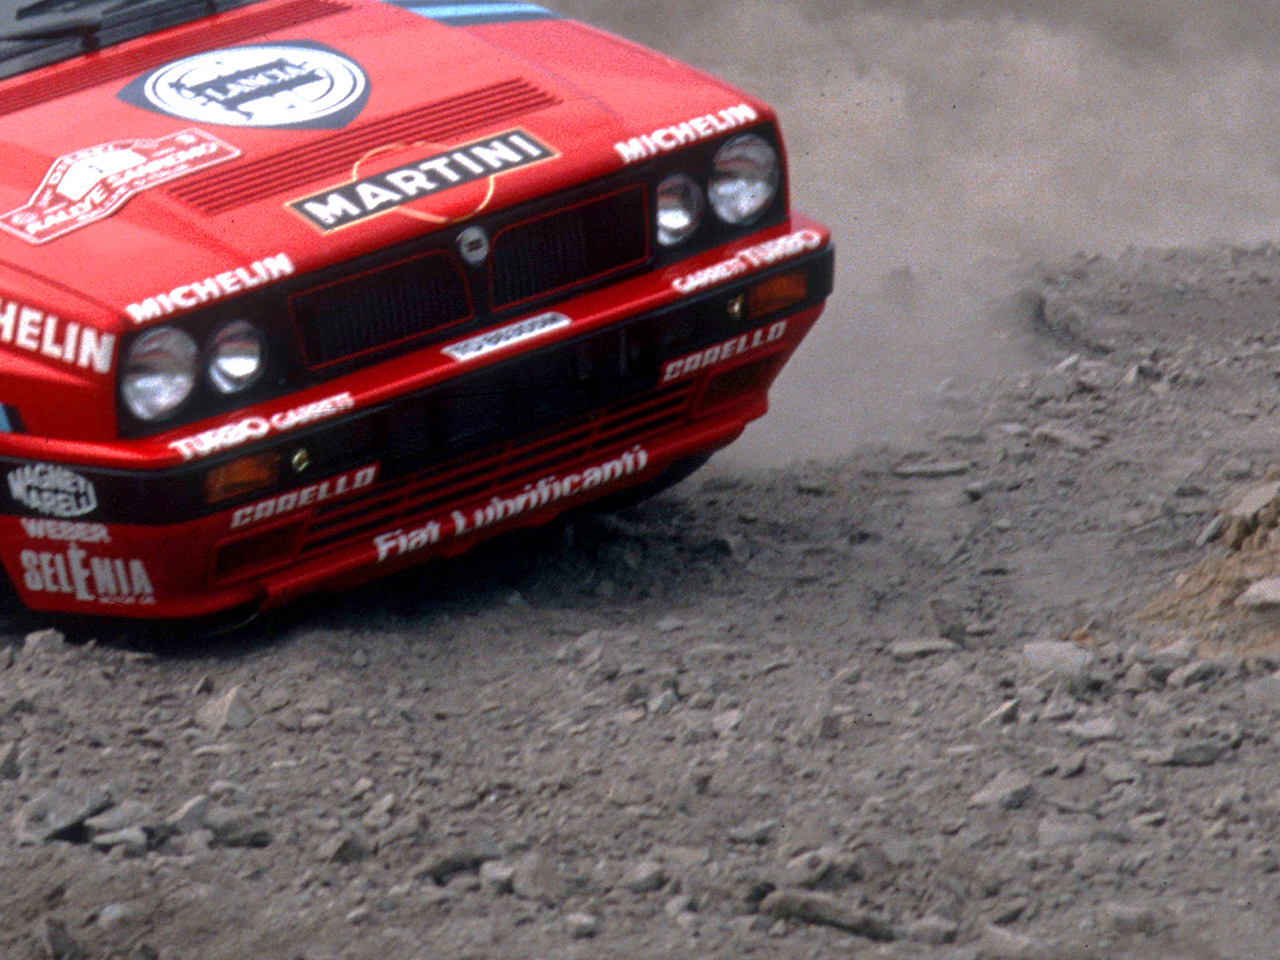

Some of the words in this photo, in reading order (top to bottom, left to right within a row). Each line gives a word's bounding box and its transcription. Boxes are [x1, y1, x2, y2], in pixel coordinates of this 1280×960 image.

[614, 104, 758, 164] MICHELIN
[303, 134, 543, 227] MARTINI
[734, 229, 822, 267] TURBO
[124, 252, 296, 325] MICHELIN
[663, 321, 787, 383] CARELLO
[167, 416, 270, 461] TURBO
[230, 466, 376, 529] CARELLO
[373, 519, 441, 564] Fiat
[450, 443, 649, 537] Lubrificanti
[19, 517, 113, 544] WEBER
[20, 541, 156, 601] SELENIA
